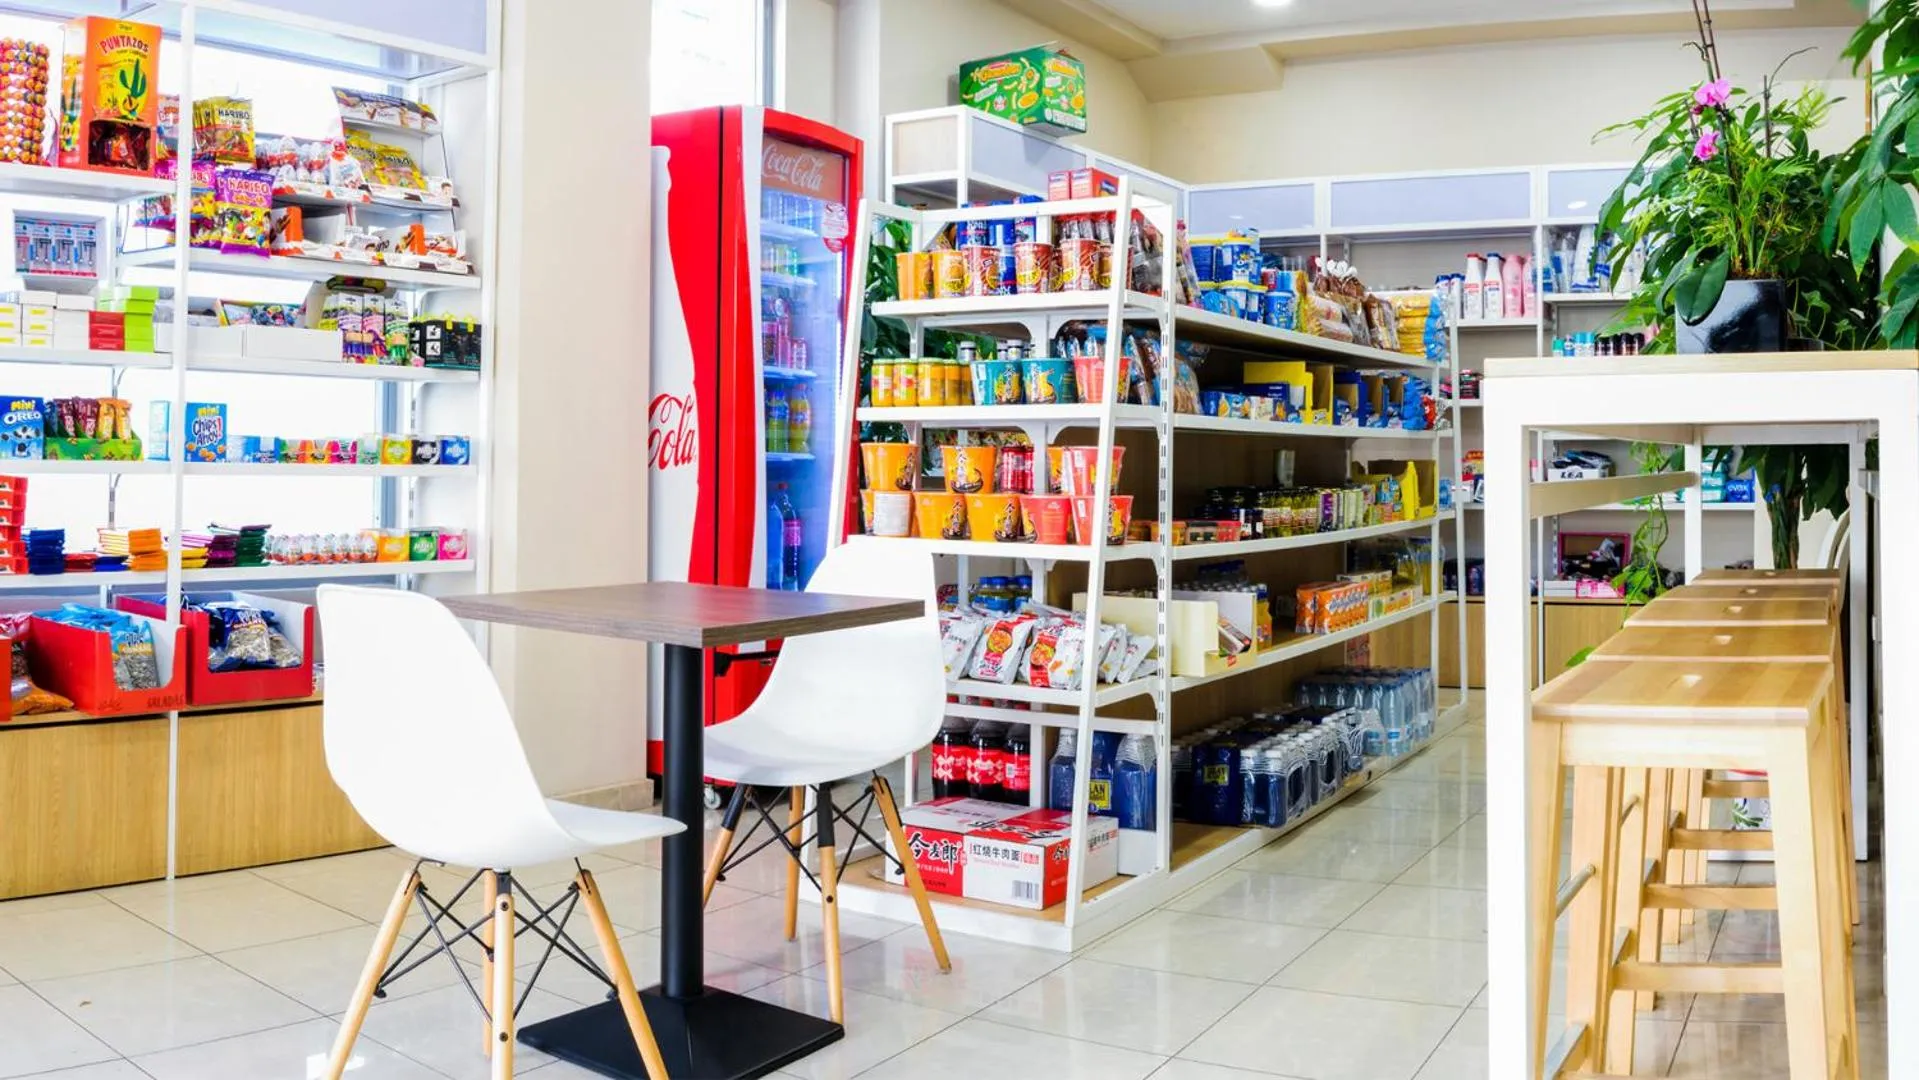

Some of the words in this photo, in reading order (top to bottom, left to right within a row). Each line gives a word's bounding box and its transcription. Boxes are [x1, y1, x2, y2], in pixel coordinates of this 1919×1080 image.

[100, 36, 149, 53] PUNTAZOS
[218, 108, 250, 119] HARIBO
[228, 177, 270, 193] HARIBO
[11, 400, 35, 410] mini
[4, 411, 41, 424] OREO
[909, 833, 958, 874] 今麦郎
[973, 844, 1020, 861] 红烧牛肉面
